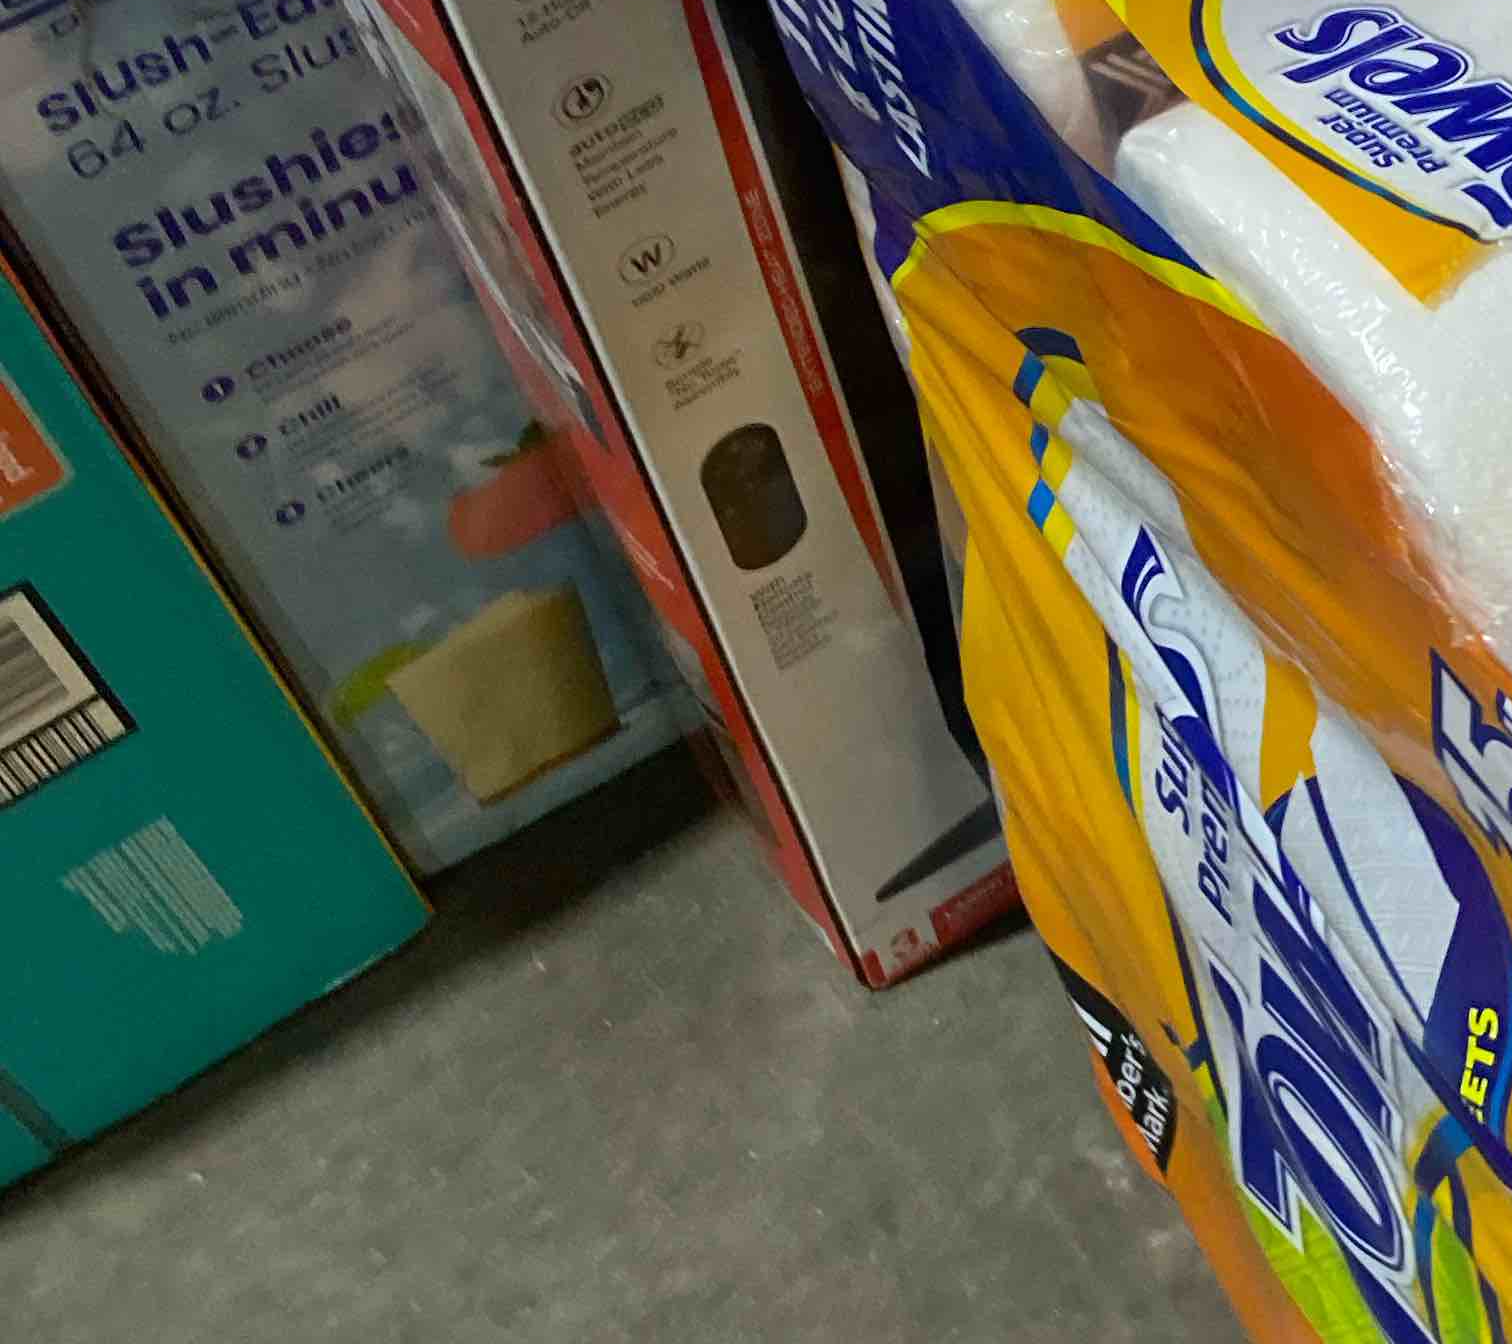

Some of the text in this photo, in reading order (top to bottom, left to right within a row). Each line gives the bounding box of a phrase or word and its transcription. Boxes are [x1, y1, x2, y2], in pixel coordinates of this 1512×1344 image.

[66, 118, 148, 180] 64
[163, 85, 242, 139] oz.
[1317, 111, 1411, 171] Super
[1325, 87, 1441, 176] Premium
[135, 266, 219, 321] in
